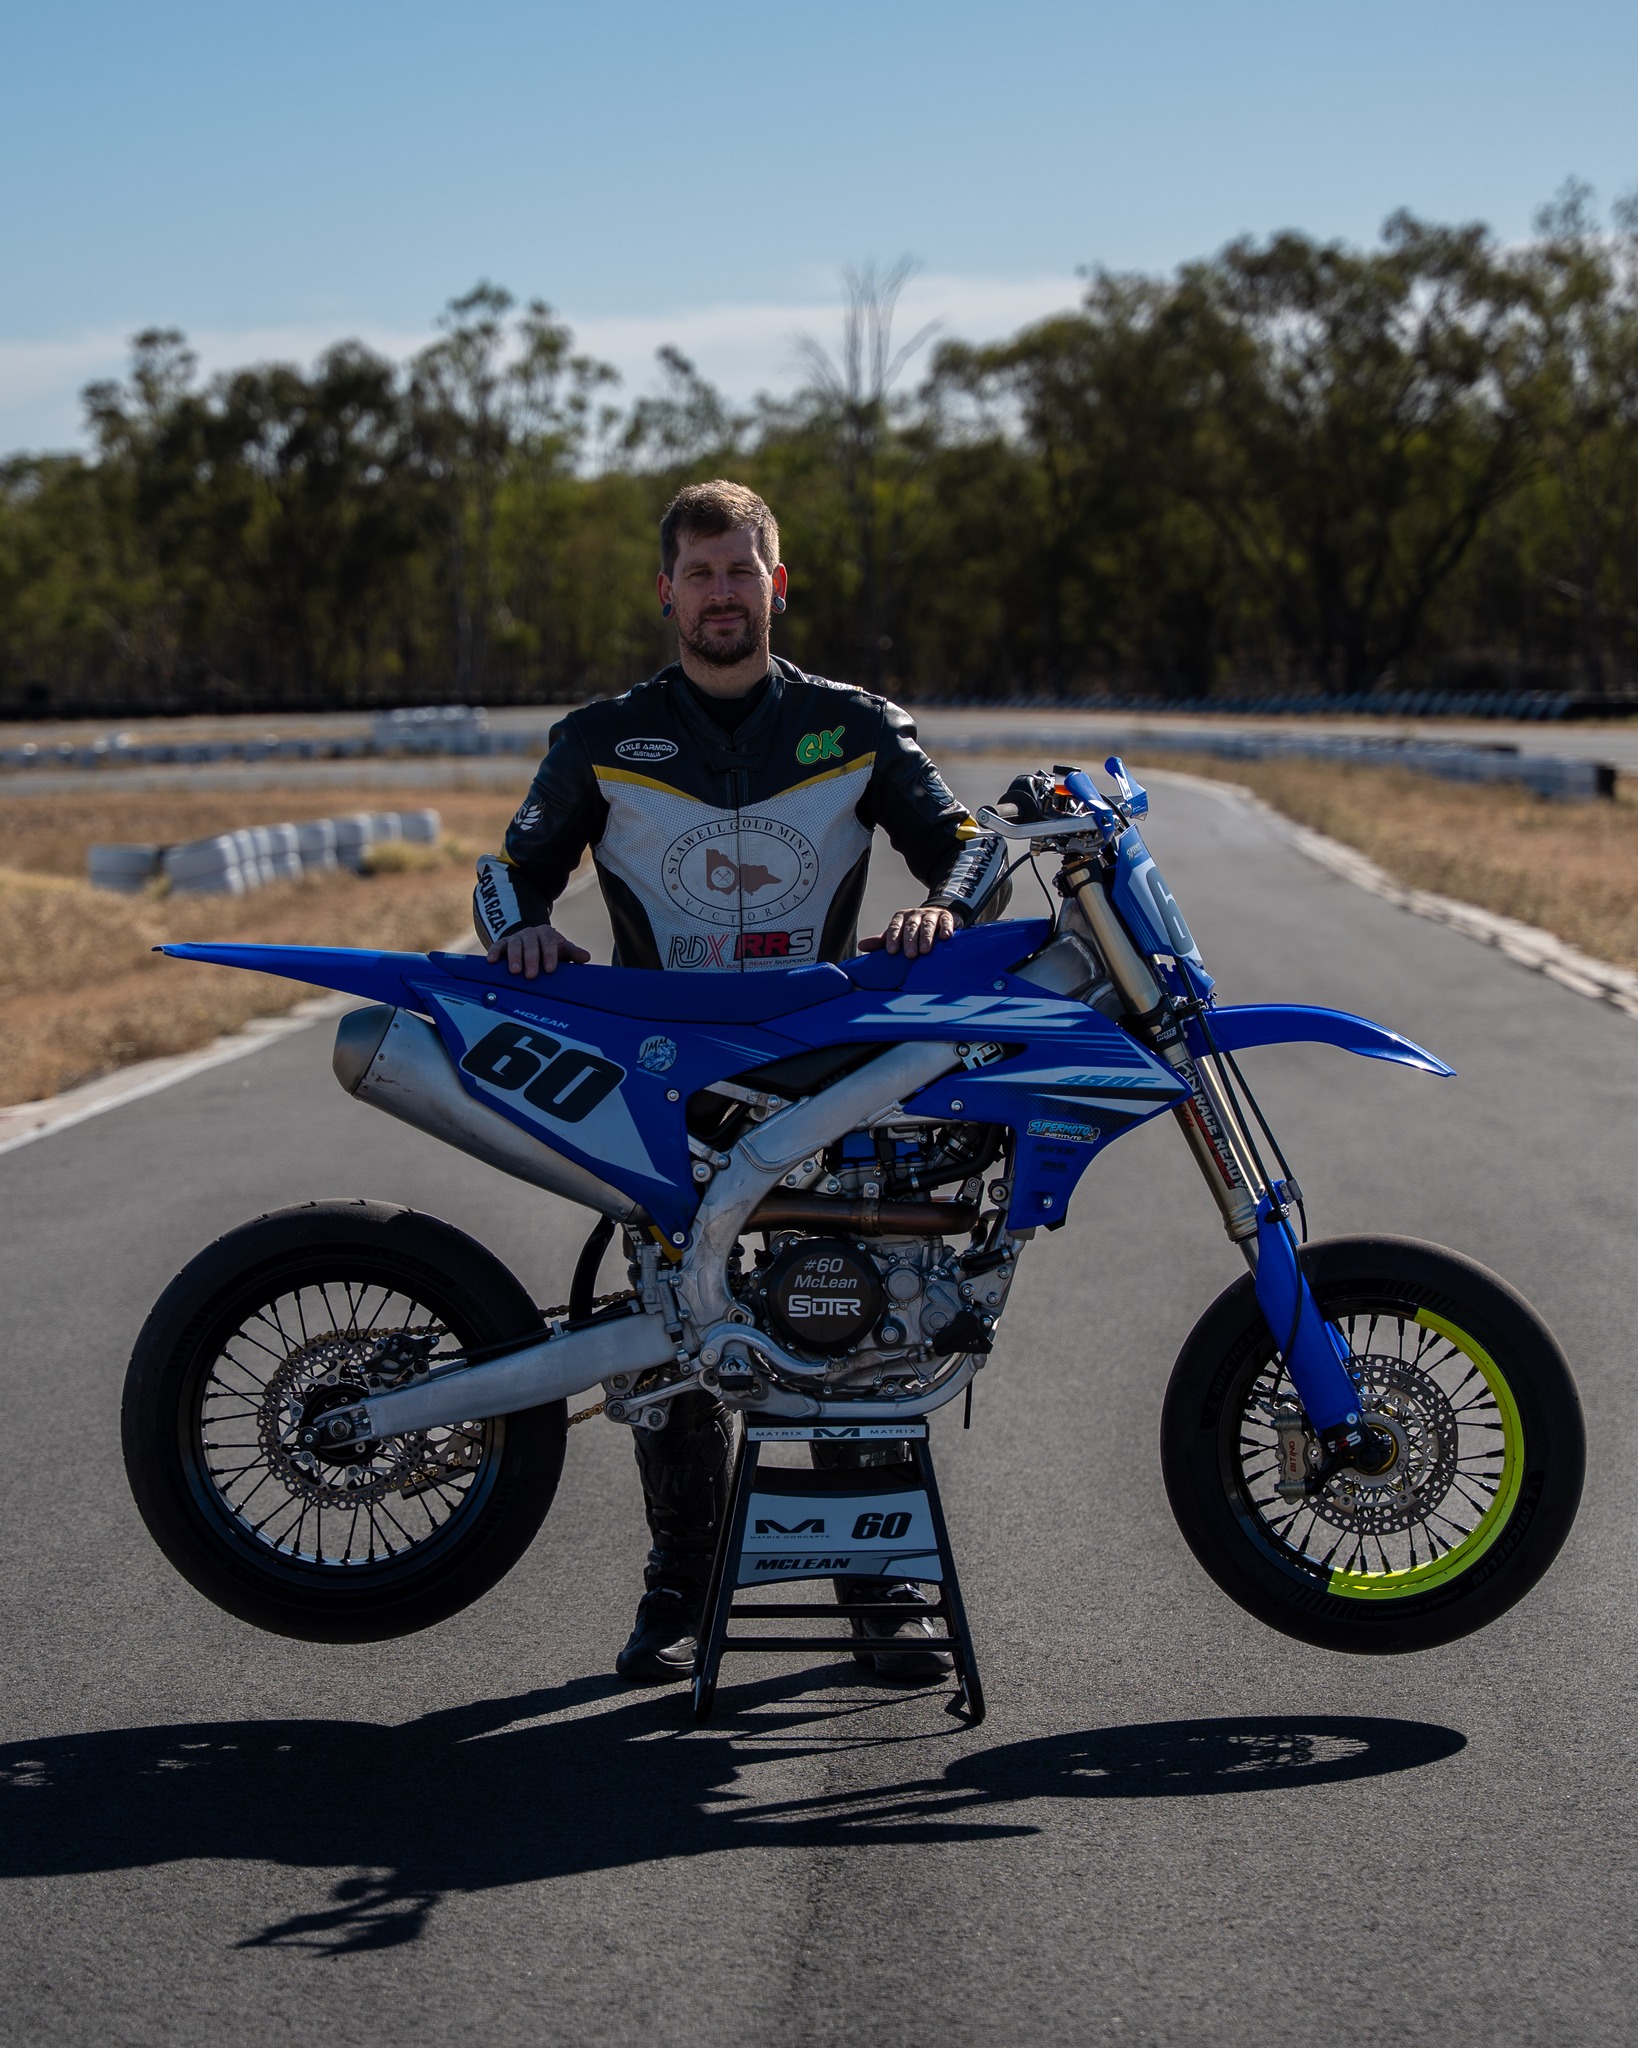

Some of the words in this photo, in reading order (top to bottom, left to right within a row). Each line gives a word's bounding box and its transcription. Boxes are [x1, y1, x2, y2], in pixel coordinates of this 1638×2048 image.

[620, 743, 640, 752] AXLE
[643, 744, 673, 752] ARMOR
[633, 750, 661, 758] AUSTRALIA
[796, 726, 845, 764] GK
[668, 822, 726, 875] STAWELL
[730, 818, 773, 831] GOLD
[777, 826, 814, 870] MINES
[684, 893, 801, 924] VICTORIA
[667, 934, 729, 969] RDX
[733, 928, 814, 962] RRS
[774, 956, 816, 965] SUSPENSION
[513, 1008, 570, 1030] MCLEAN
[848, 994, 1094, 1028] YZ
[461, 1022, 626, 1122] 60
[1055, 1074, 1162, 1087] 450F
[1029, 1120, 1091, 1137] SUPERMOTO
[1045, 1132, 1082, 1141] INSTITUTE
[1193, 1094, 1220, 1136] RACE
[1213, 1136, 1249, 1189] READY
[803, 1258, 844, 1273] #60
[794, 1275, 858, 1289] McLean
[788, 1294, 861, 1318] SUTER
[851, 1512, 913, 1540] 60
[754, 1558, 851, 1570] MCLEAN
